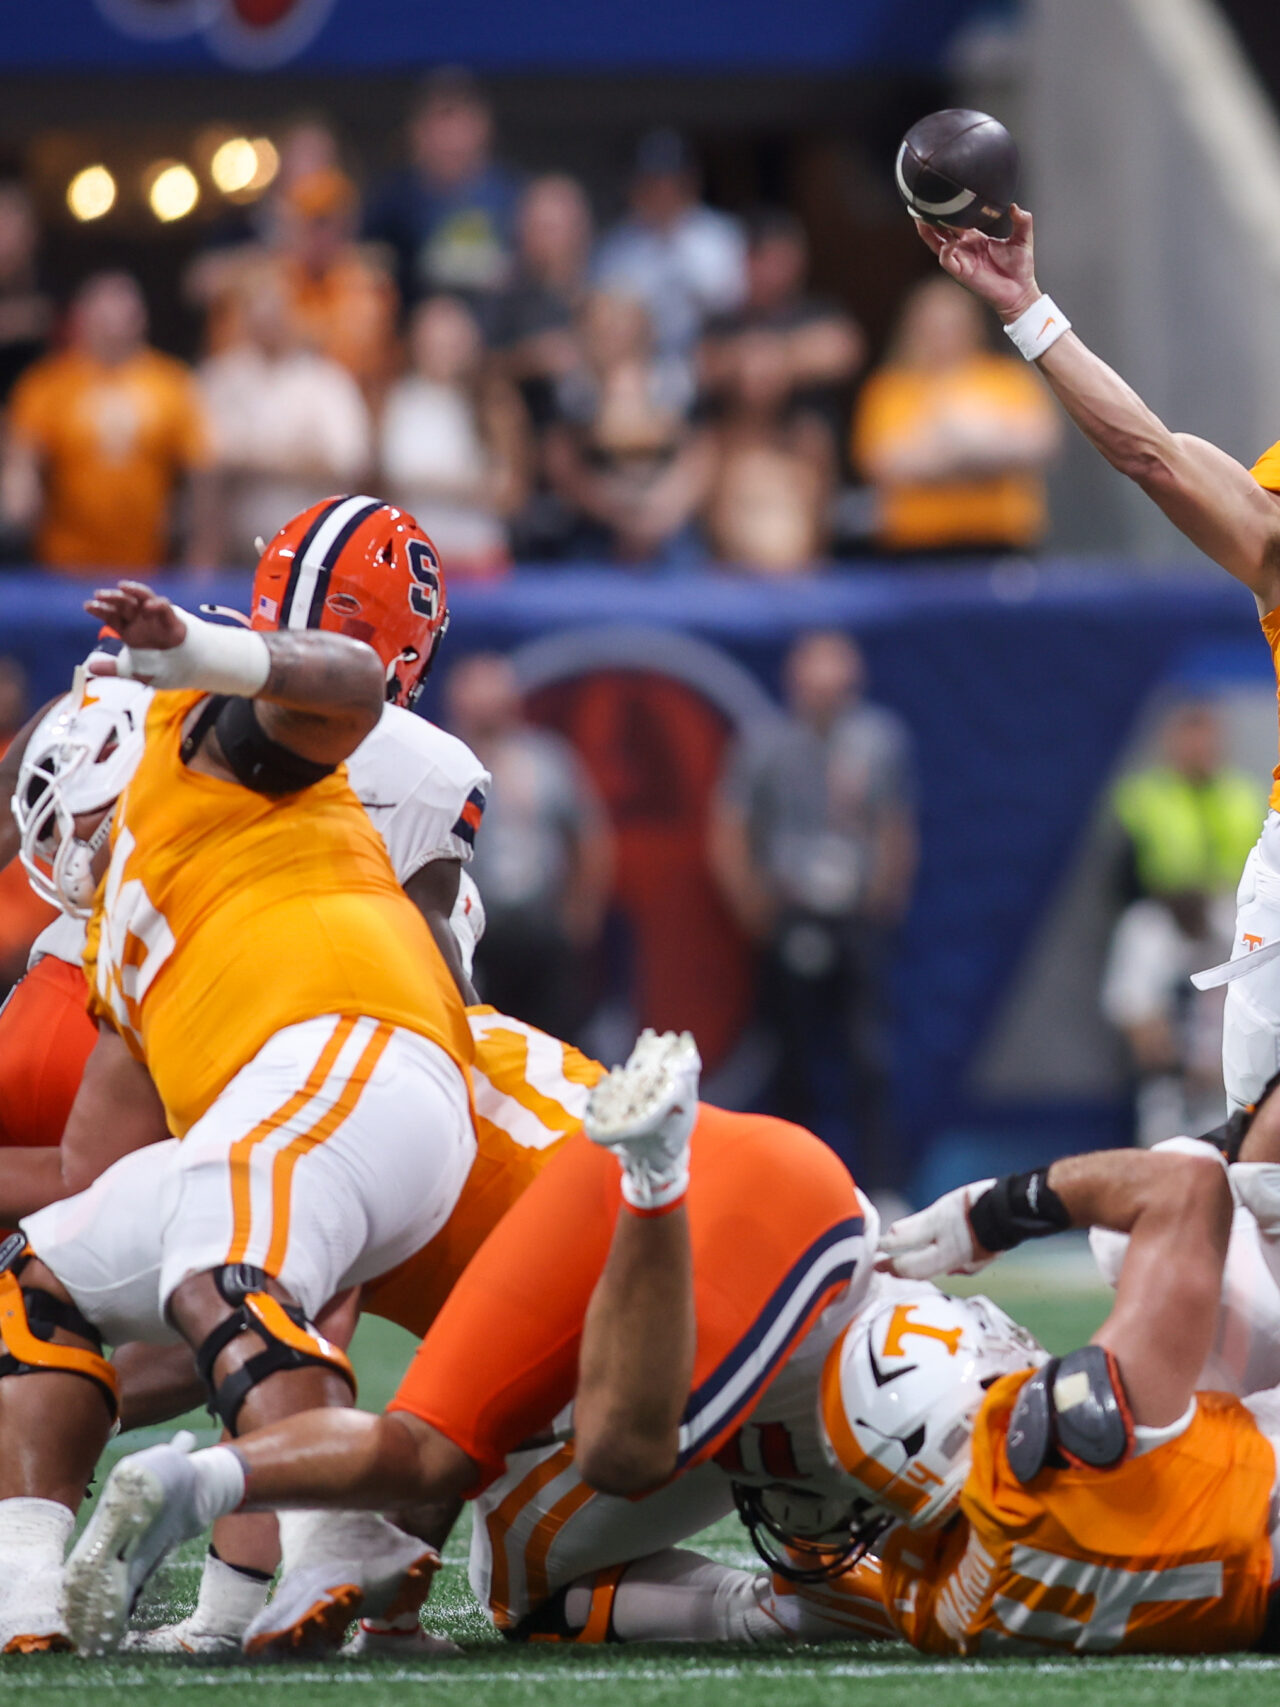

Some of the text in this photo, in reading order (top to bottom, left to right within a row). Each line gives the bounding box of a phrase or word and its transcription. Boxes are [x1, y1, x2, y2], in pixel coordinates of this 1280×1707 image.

[404, 538, 440, 621] S
[1242, 933, 1263, 952] T
[882, 1304, 963, 1358] T
[992, 1543, 1223, 1650] 4
